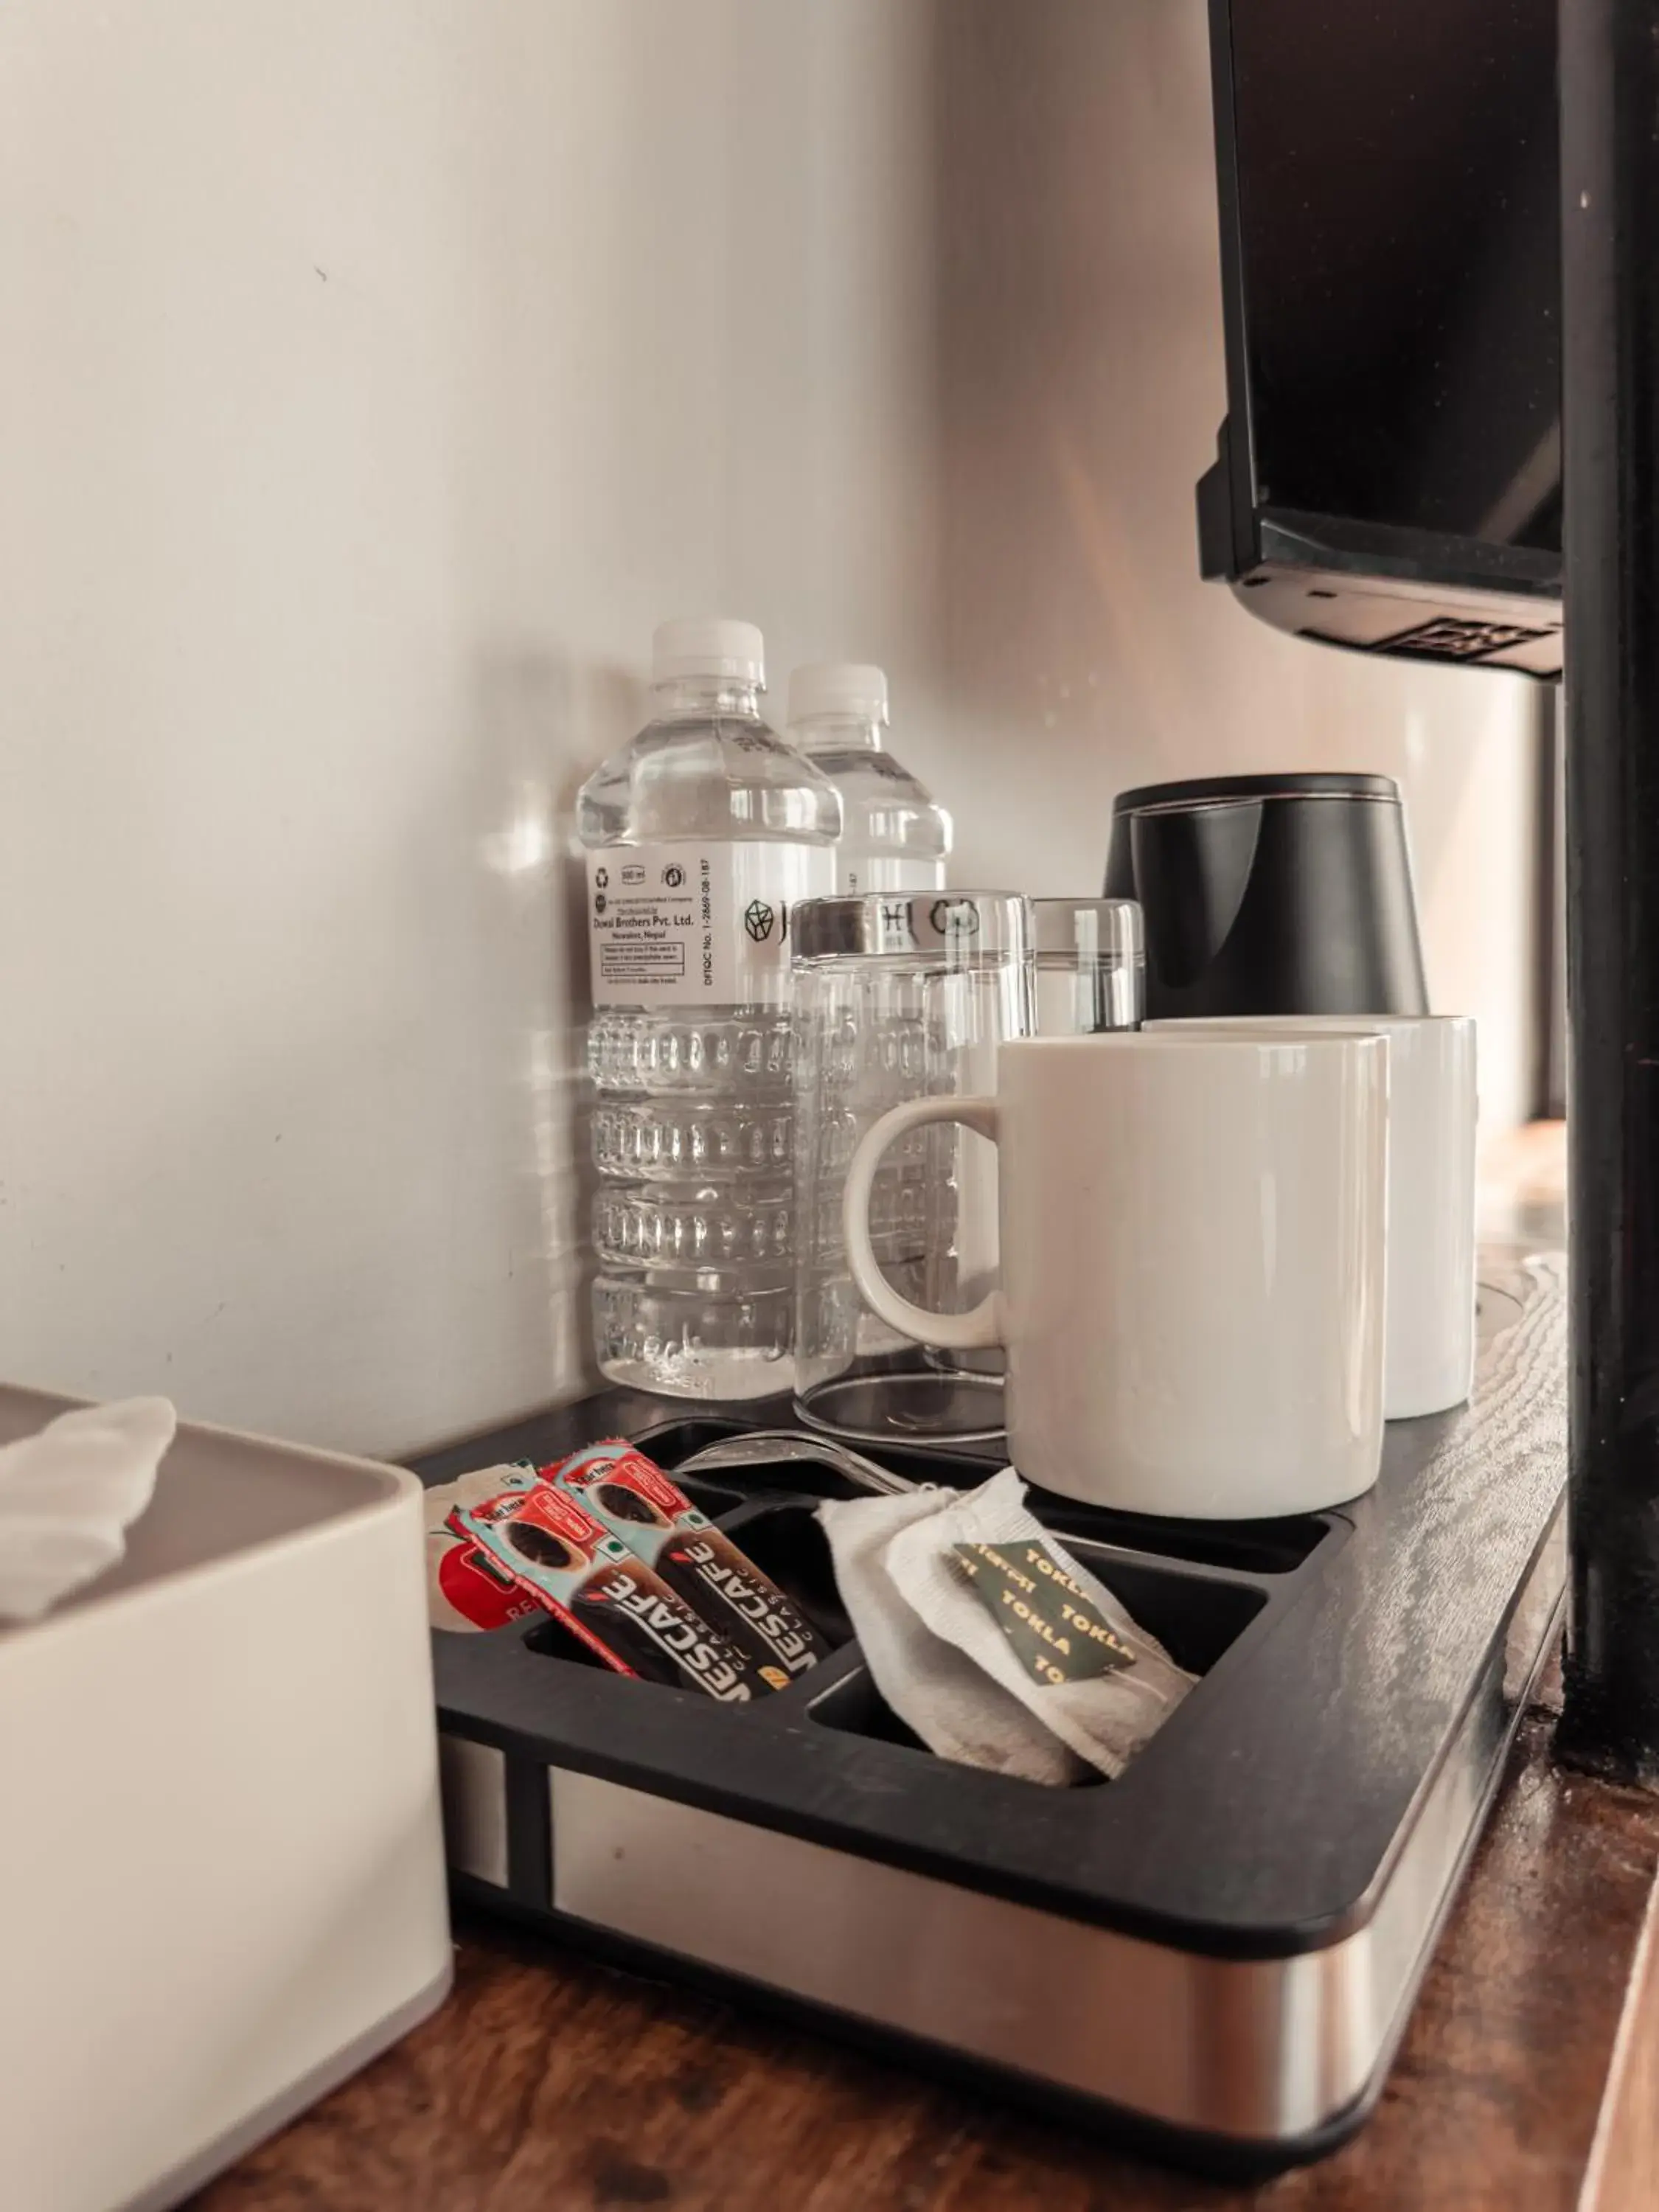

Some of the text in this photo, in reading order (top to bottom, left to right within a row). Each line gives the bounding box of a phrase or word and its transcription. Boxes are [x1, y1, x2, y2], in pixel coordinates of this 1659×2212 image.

[616, 915, 650, 928] Brothers
[653, 914, 672, 927] Pvt.
[674, 914, 695, 926] Ltd.
[703, 933, 712, 950] No.
[505, 1598, 539, 1621] RE
[737, 1567, 814, 1642] CLASSIC
[1002, 1589, 1071, 1655] TOKLA
